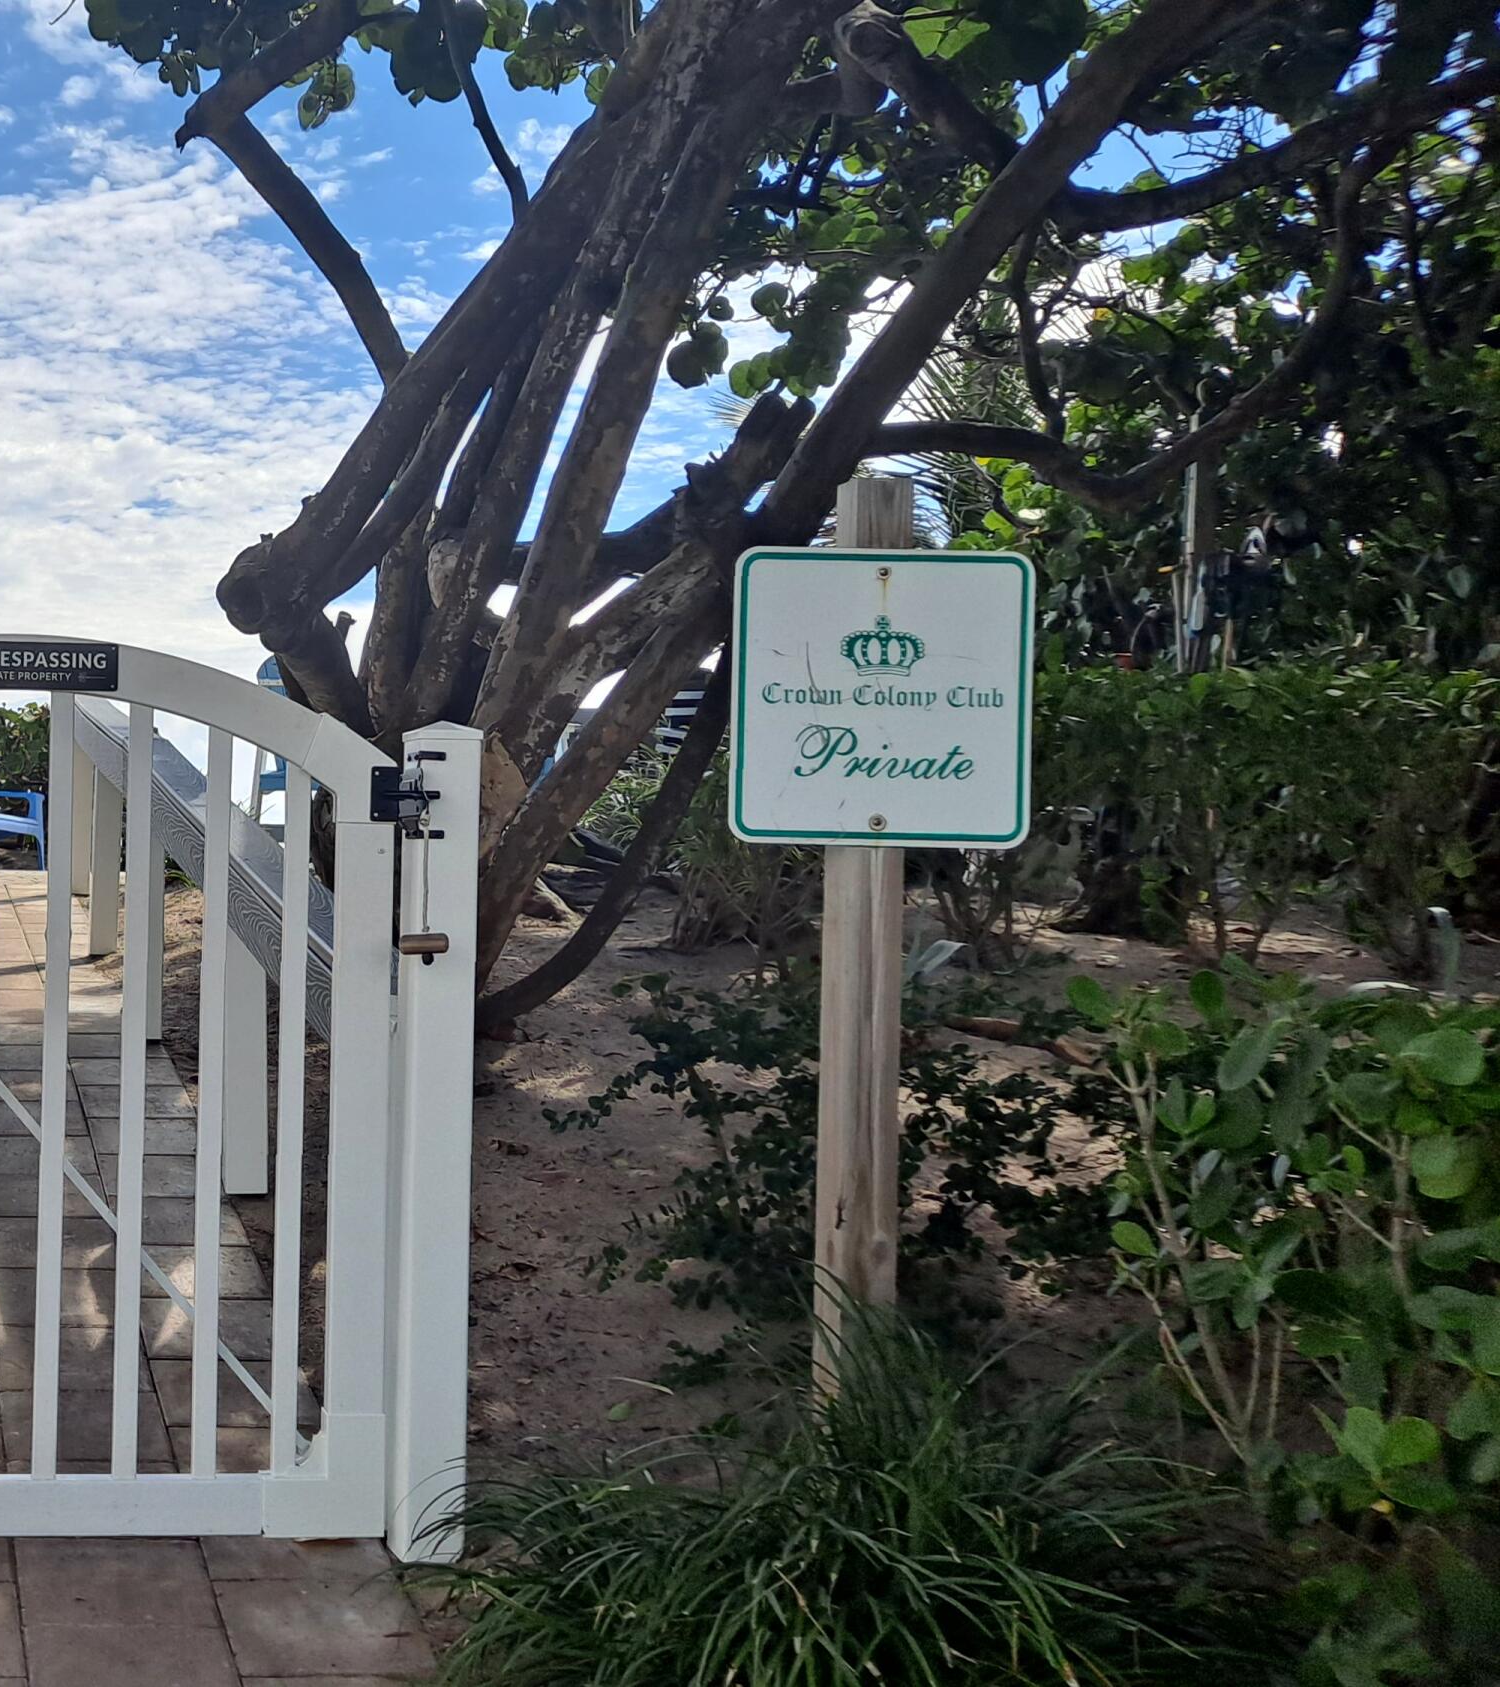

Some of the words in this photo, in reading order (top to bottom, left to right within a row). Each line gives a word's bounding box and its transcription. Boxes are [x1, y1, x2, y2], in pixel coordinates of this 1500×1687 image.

[17, 672, 72, 682] PROPERTY
[762, 682, 843, 705] Crown
[852, 684, 937, 711] Colony
[946, 686, 1004, 708] Club
[794, 723, 975, 780] Private
